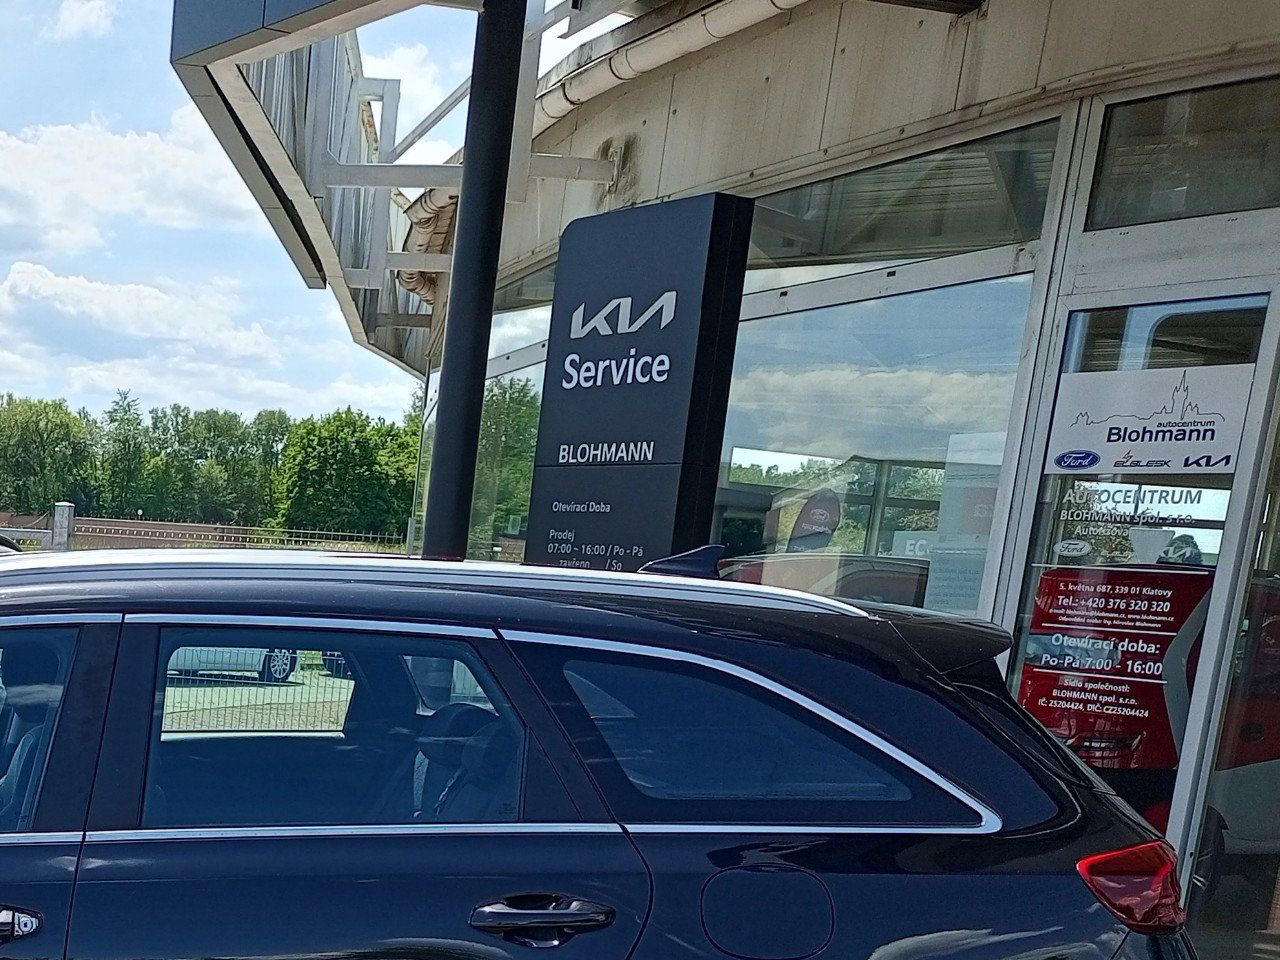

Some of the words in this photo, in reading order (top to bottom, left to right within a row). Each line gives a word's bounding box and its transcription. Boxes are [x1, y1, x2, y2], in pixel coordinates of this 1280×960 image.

[570, 290, 677, 339] KIA
[561, 348, 670, 389] Service
[1156, 420, 1215, 428] autocentrum
[1106, 426, 1216, 444] Blohmann
[558, 441, 654, 464] BLOHMANN
[1183, 454, 1232, 468] KIA
[1062, 489, 1203, 504] AUTOCENTRUM
[552, 501, 588, 512] Otevírací
[589, 502, 611, 513] Doba
[1060, 510, 1130, 522] BLOHMANN
[1134, 511, 1163, 526] spol.
[1176, 514, 1196, 524] r.o.
[548, 529, 576, 542] Prodej
[548, 544, 572, 554] 07:00
[581, 544, 606, 555] 16:00
[613, 546, 624, 556] Po
[632, 546, 644, 556] Pá
[612, 560, 622, 570] So
[1068, 583, 1094, 592] května
[1096, 584, 1113, 594] 687,
[1114, 586, 1129, 594] 339
[1130, 586, 1140, 594] 01
[1142, 587, 1173, 598] Klatovy
[1107, 598, 1126, 610] 376
[1128, 600, 1148, 610] 320
[1150, 601, 1170, 612] 320
[1052, 634, 1114, 650] Otevírací
[1118, 638, 1160, 654] doba:
[1041, 654, 1080, 668] Po-Pá
[1084, 658, 1112, 670] 7:00
[1126, 660, 1163, 676] 16:00
[1064, 679, 1082, 688] Sídlo
[1084, 680, 1130, 692] společnosti:
[1052, 689, 1098, 701] BLOHMANN
[1099, 694, 1117, 704] spol.
[1118, 696, 1138, 705] s.r.o.
[1048, 700, 1084, 712] 25204424,
[1103, 705, 1149, 718] CZ25204424
